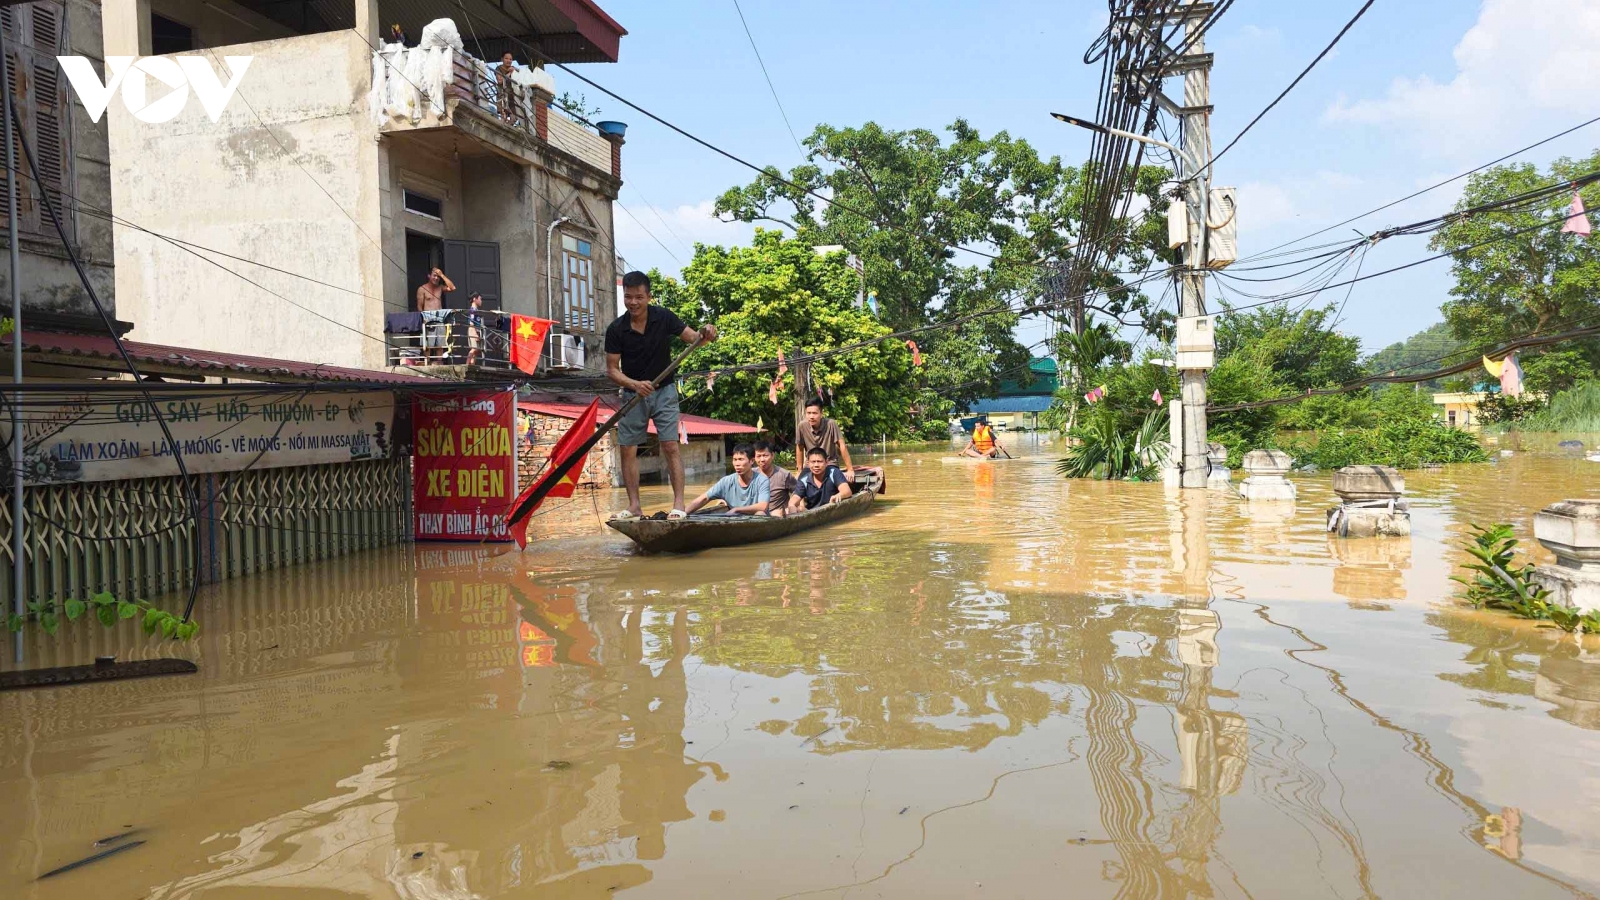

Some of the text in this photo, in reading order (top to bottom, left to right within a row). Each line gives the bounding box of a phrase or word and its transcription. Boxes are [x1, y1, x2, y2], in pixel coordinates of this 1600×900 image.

[216, 396, 250, 422] HẤP
[262, 400, 315, 425] NHUỘM
[325, 401, 340, 422] ÉP
[463, 398, 495, 415] Long
[58, 439, 94, 461] LÀM
[98, 439, 140, 460] XOĂN
[152, 436, 181, 457] LÀM
[184, 435, 223, 455] MÓNG
[232, 435, 246, 453] VẼ
[249, 434, 281, 452] MÓNG
[288, 432, 306, 450] NỐI
[307, 436, 319, 450] MI
[321, 433, 351, 448] MASSA
[417, 418, 512, 457] SỬA CHỮA
[426, 463, 504, 504] XE ĐIỆN
[419, 506, 511, 538] THAY BÌNH ẮC QU
